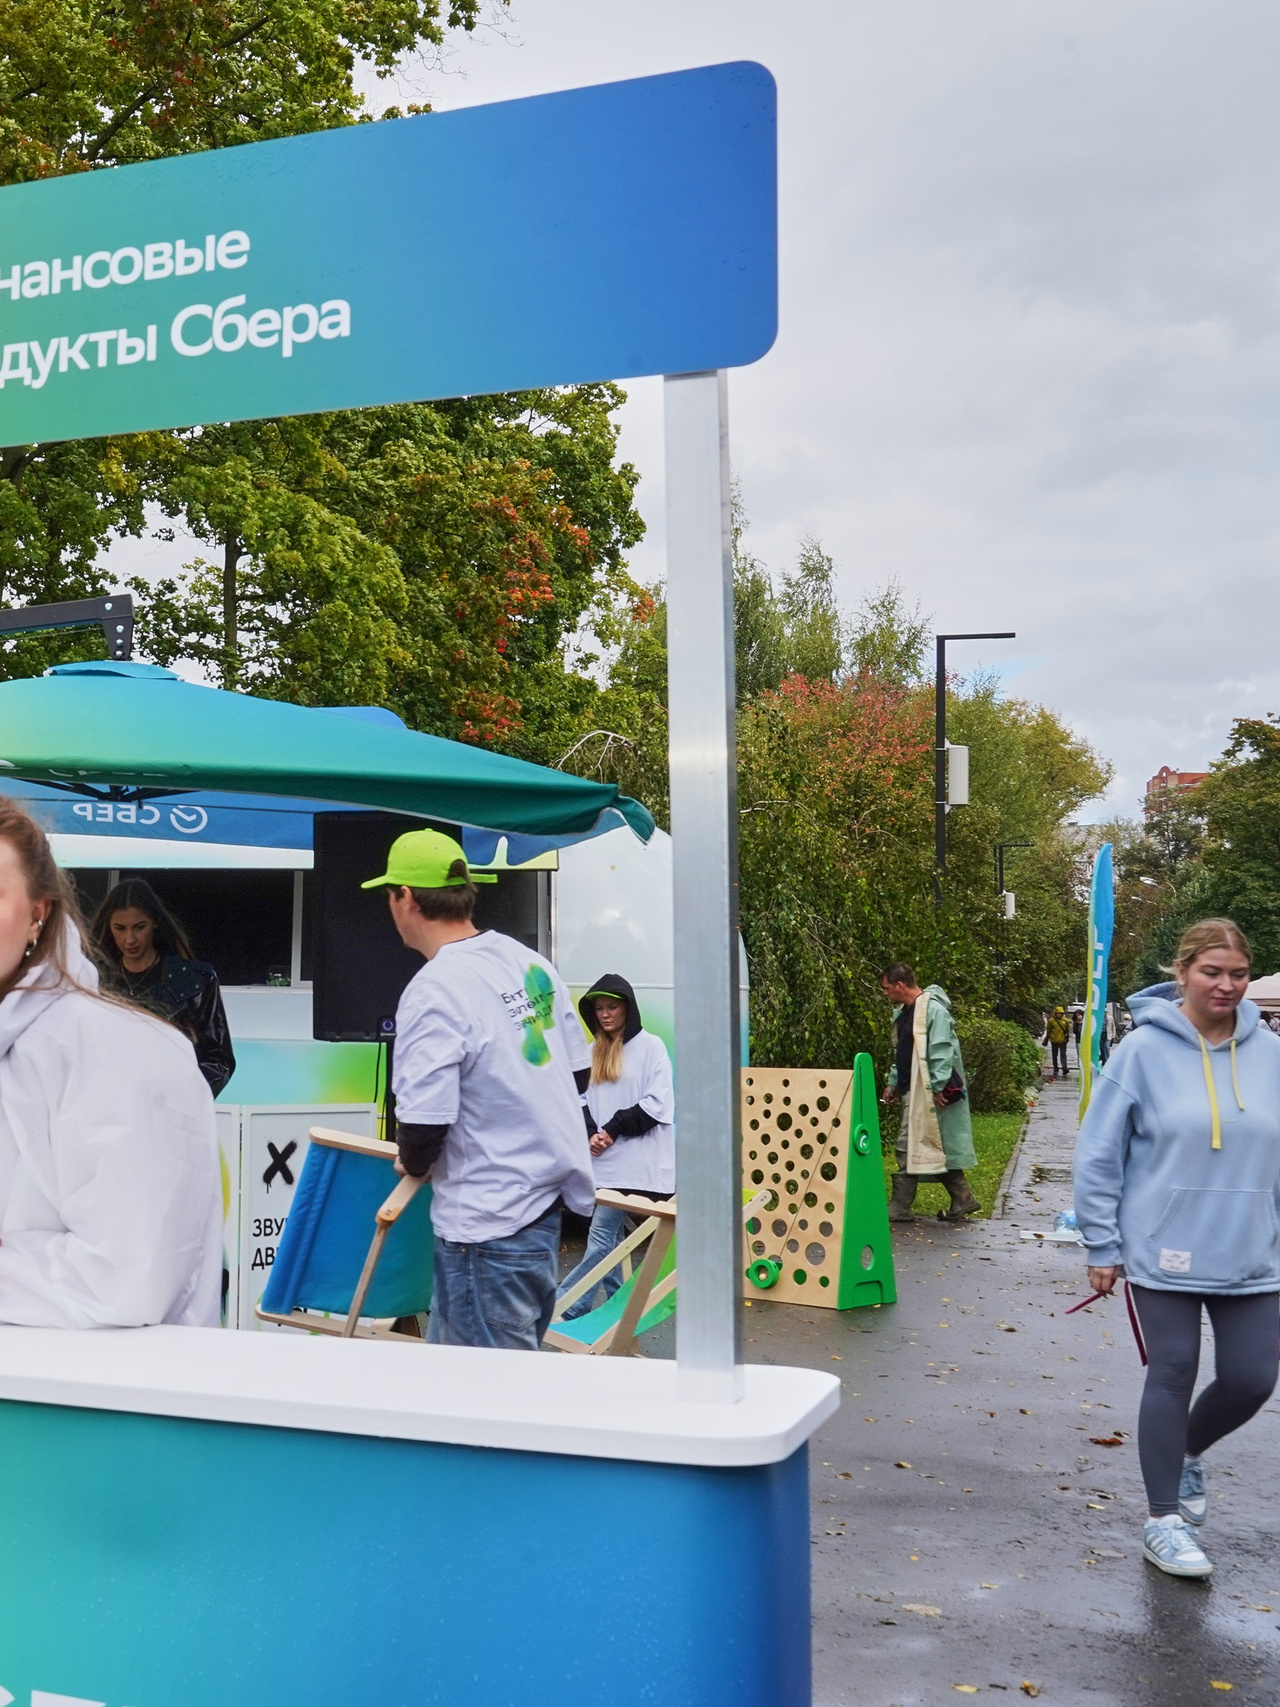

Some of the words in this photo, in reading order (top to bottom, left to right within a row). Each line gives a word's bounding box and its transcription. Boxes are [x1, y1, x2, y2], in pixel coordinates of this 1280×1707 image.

[170, 294, 352, 358] Сбера
[252, 1217, 287, 1238] ЗВУ
[251, 1247, 277, 1271] ДВ
